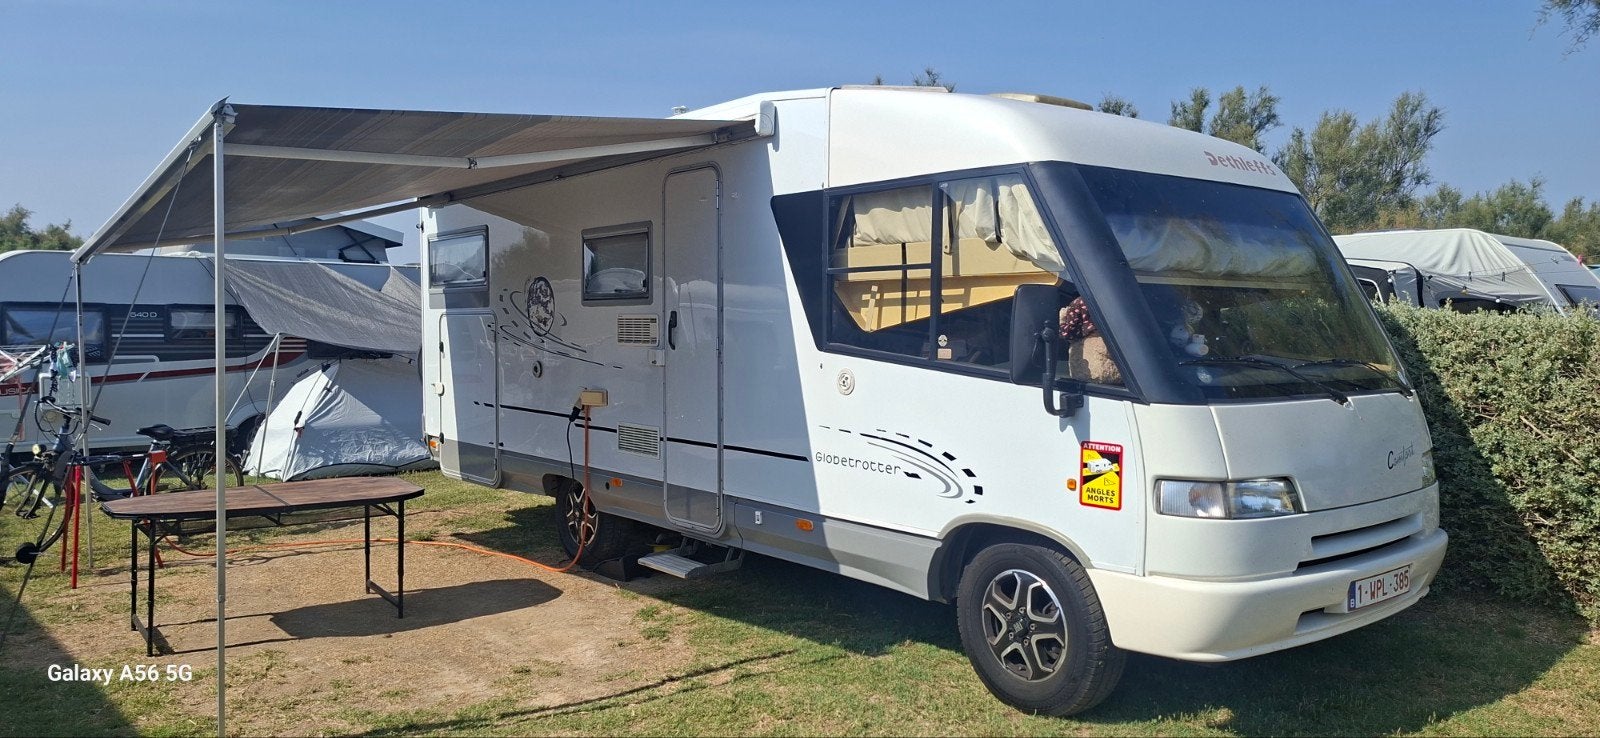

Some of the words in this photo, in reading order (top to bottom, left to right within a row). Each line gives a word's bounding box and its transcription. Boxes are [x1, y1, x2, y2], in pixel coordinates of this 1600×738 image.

[1203, 150, 1277, 176] Dethleffs
[1083, 442, 1121, 453] ATTENTION
[815, 451, 902, 475] Globetrotter
[1085, 487, 1116, 497] ANGLES
[1087, 494, 1114, 504] MORTS
